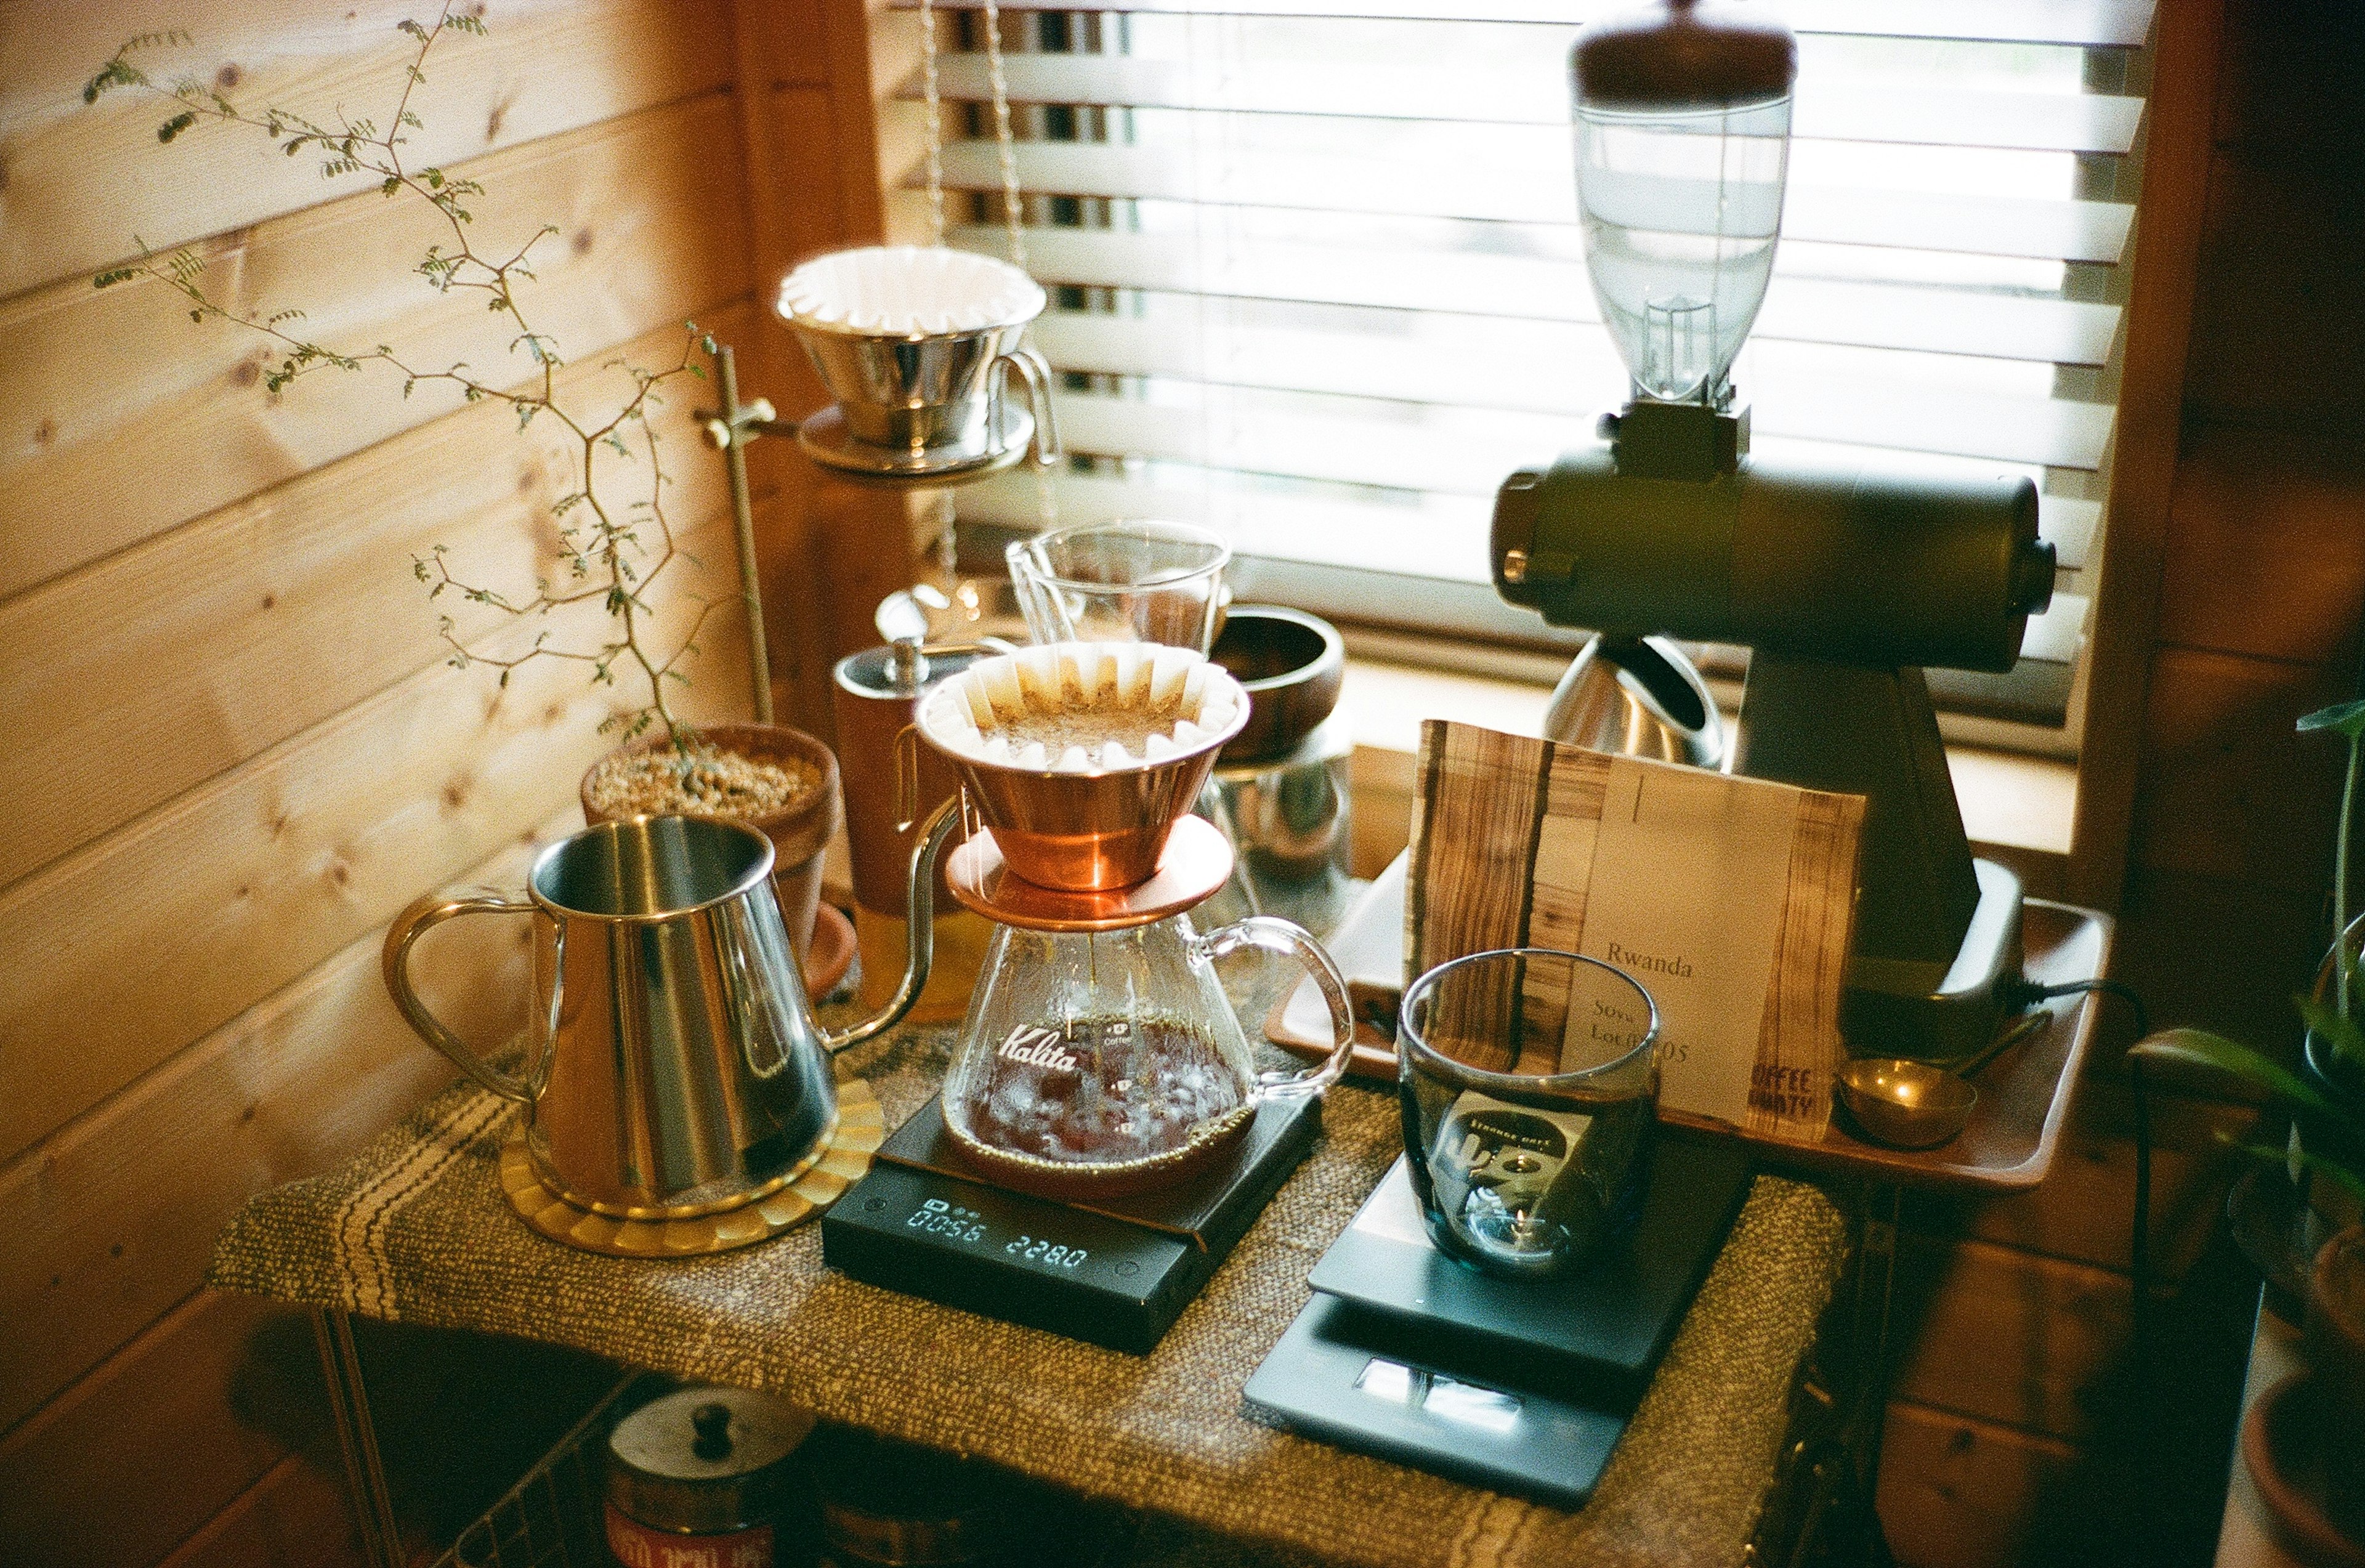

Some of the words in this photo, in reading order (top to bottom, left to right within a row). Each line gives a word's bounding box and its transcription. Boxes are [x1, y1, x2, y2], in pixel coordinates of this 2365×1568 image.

[1607, 942, 1692, 978] Rwanda
[998, 1024, 1077, 1072] Kalita
[908, 1210, 987, 1242] 00:56
